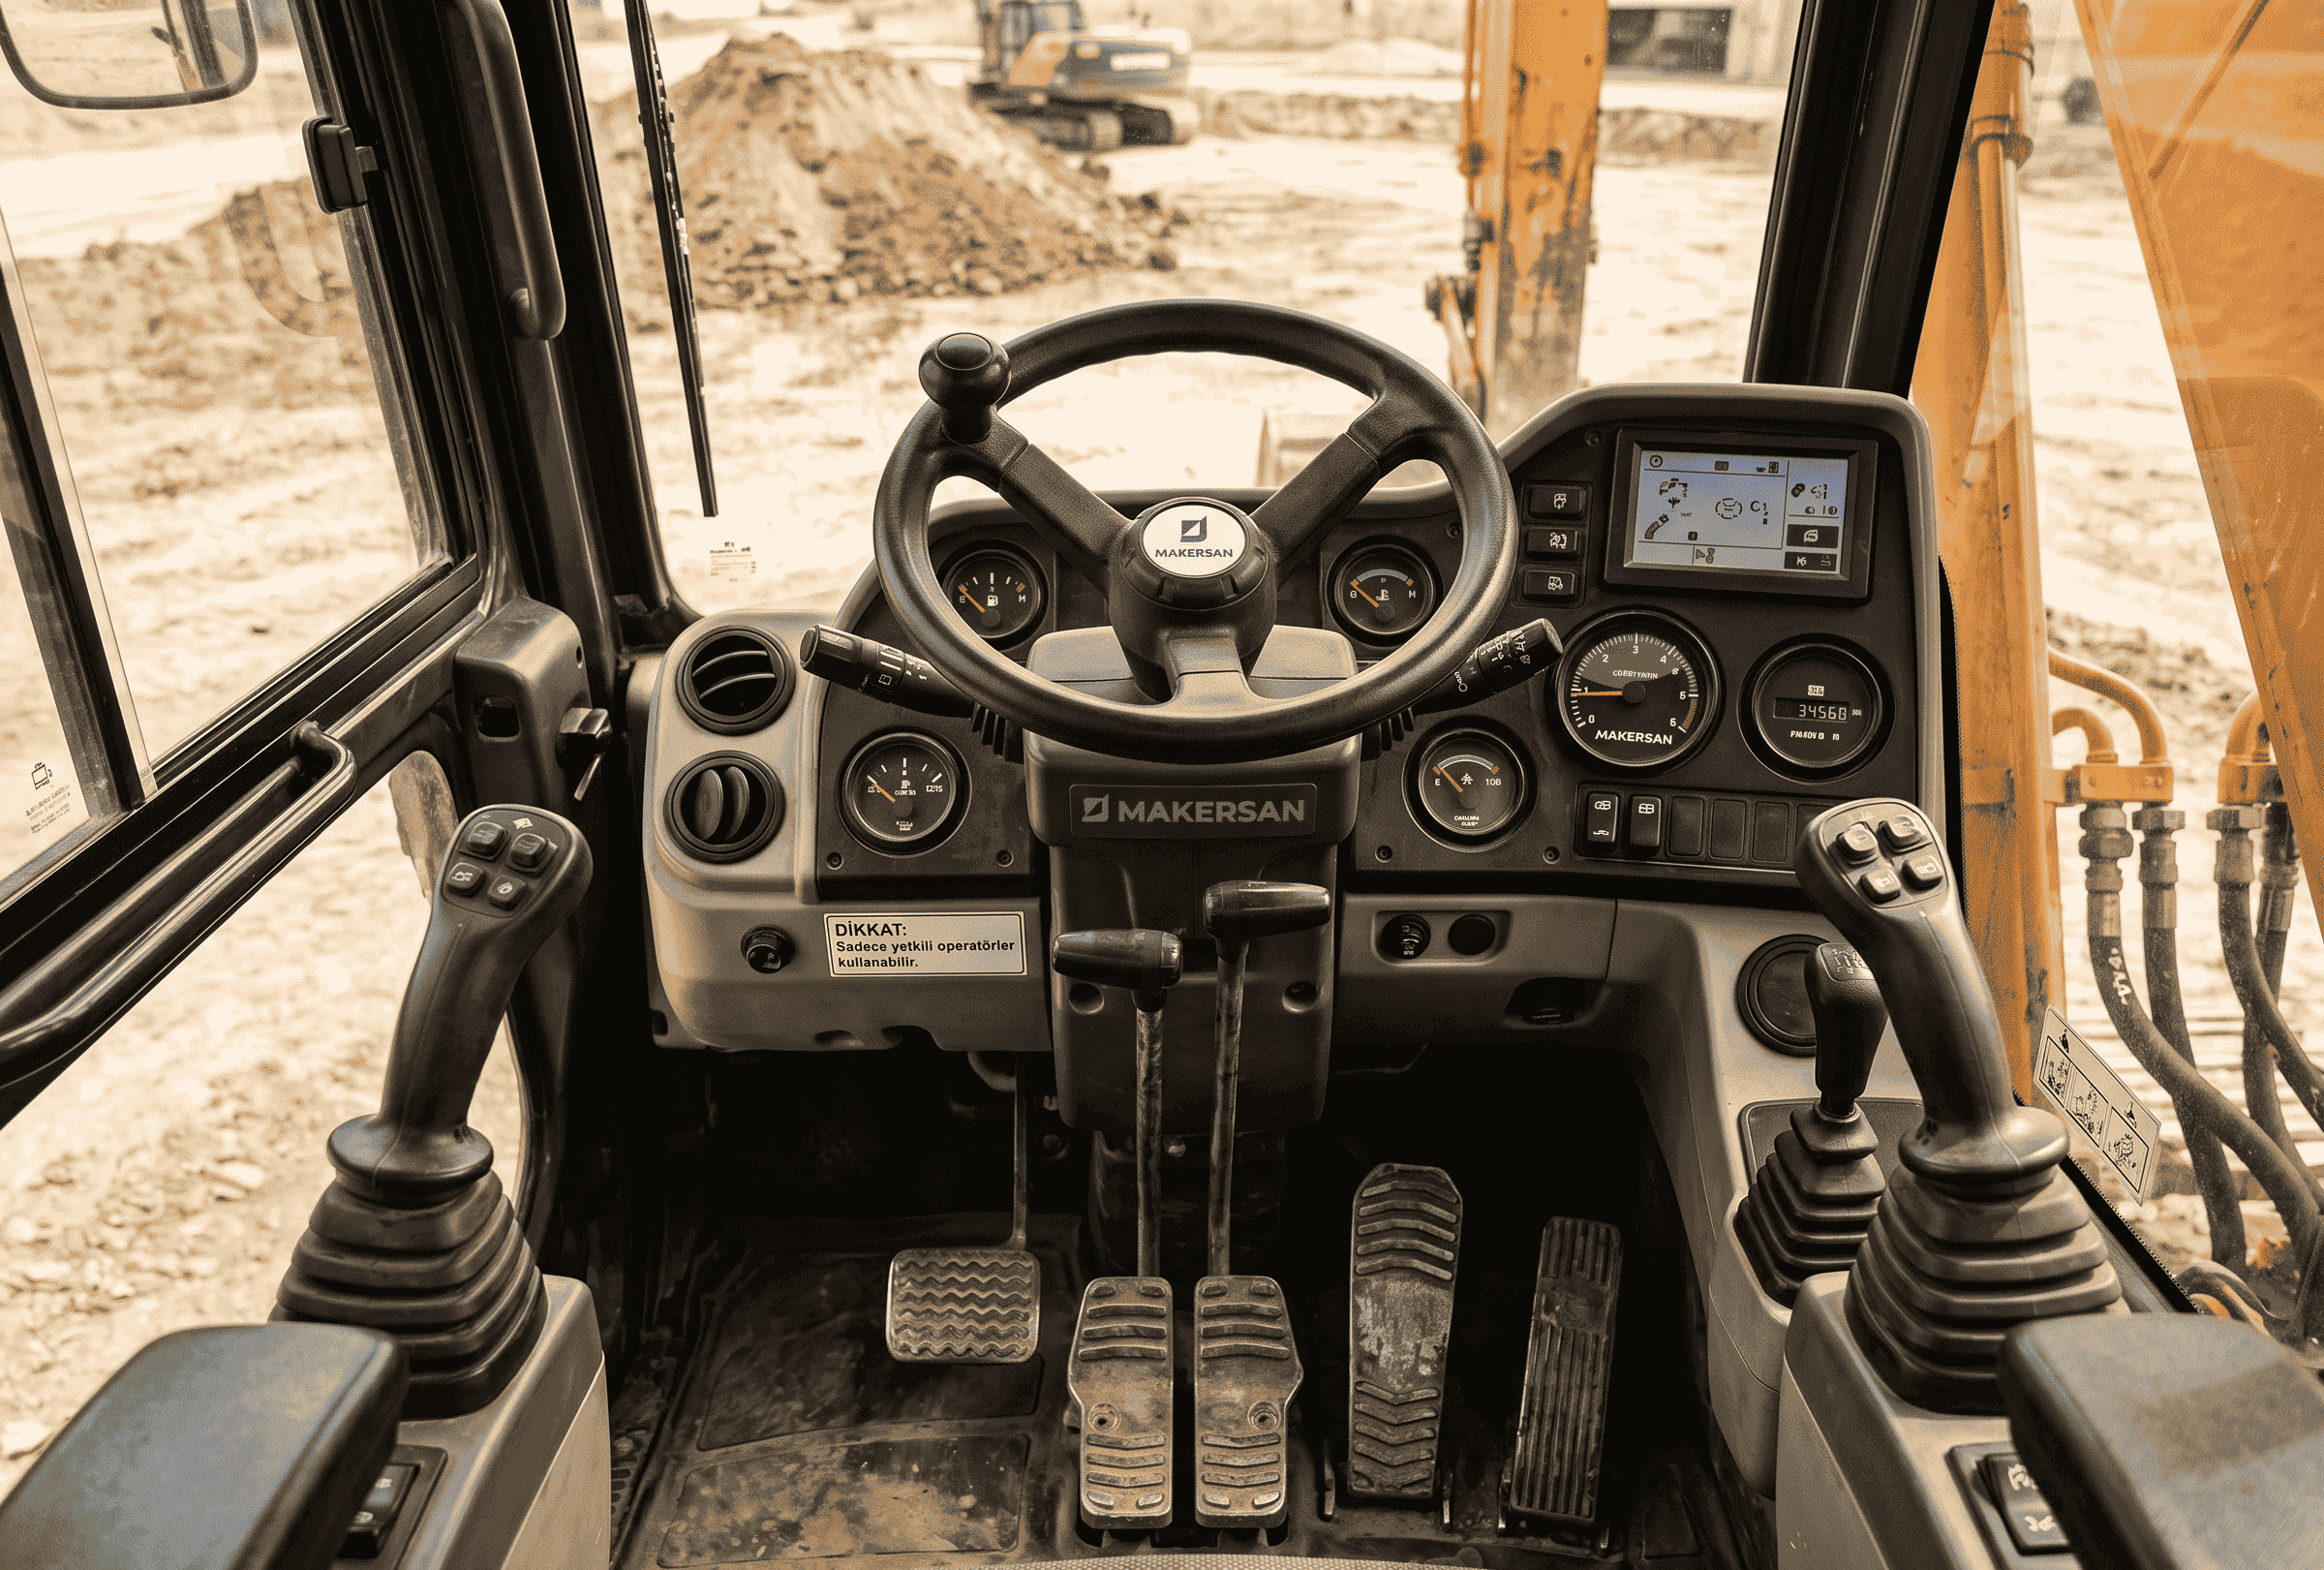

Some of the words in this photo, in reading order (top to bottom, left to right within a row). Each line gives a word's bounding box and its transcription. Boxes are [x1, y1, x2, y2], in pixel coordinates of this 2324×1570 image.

[1155, 548, 1234, 558] MAKERSAN
[1632, 645, 1639, 655] 3
[1602, 654, 1609, 662] 2
[1660, 655, 1667, 663] 4
[1679, 691, 1687, 700] 5
[1669, 718, 1677, 727] 6
[1595, 729, 1673, 745] MAKERSAN
[1118, 799, 1304, 823] MAKERSAN
[835, 921, 907, 937] DİKKAT:
[837, 940, 887, 952] Sadece
[891, 940, 933, 954] yetkili
[937, 939, 1015, 954] operatörler
[838, 957, 919, 968] kullanabilir.
